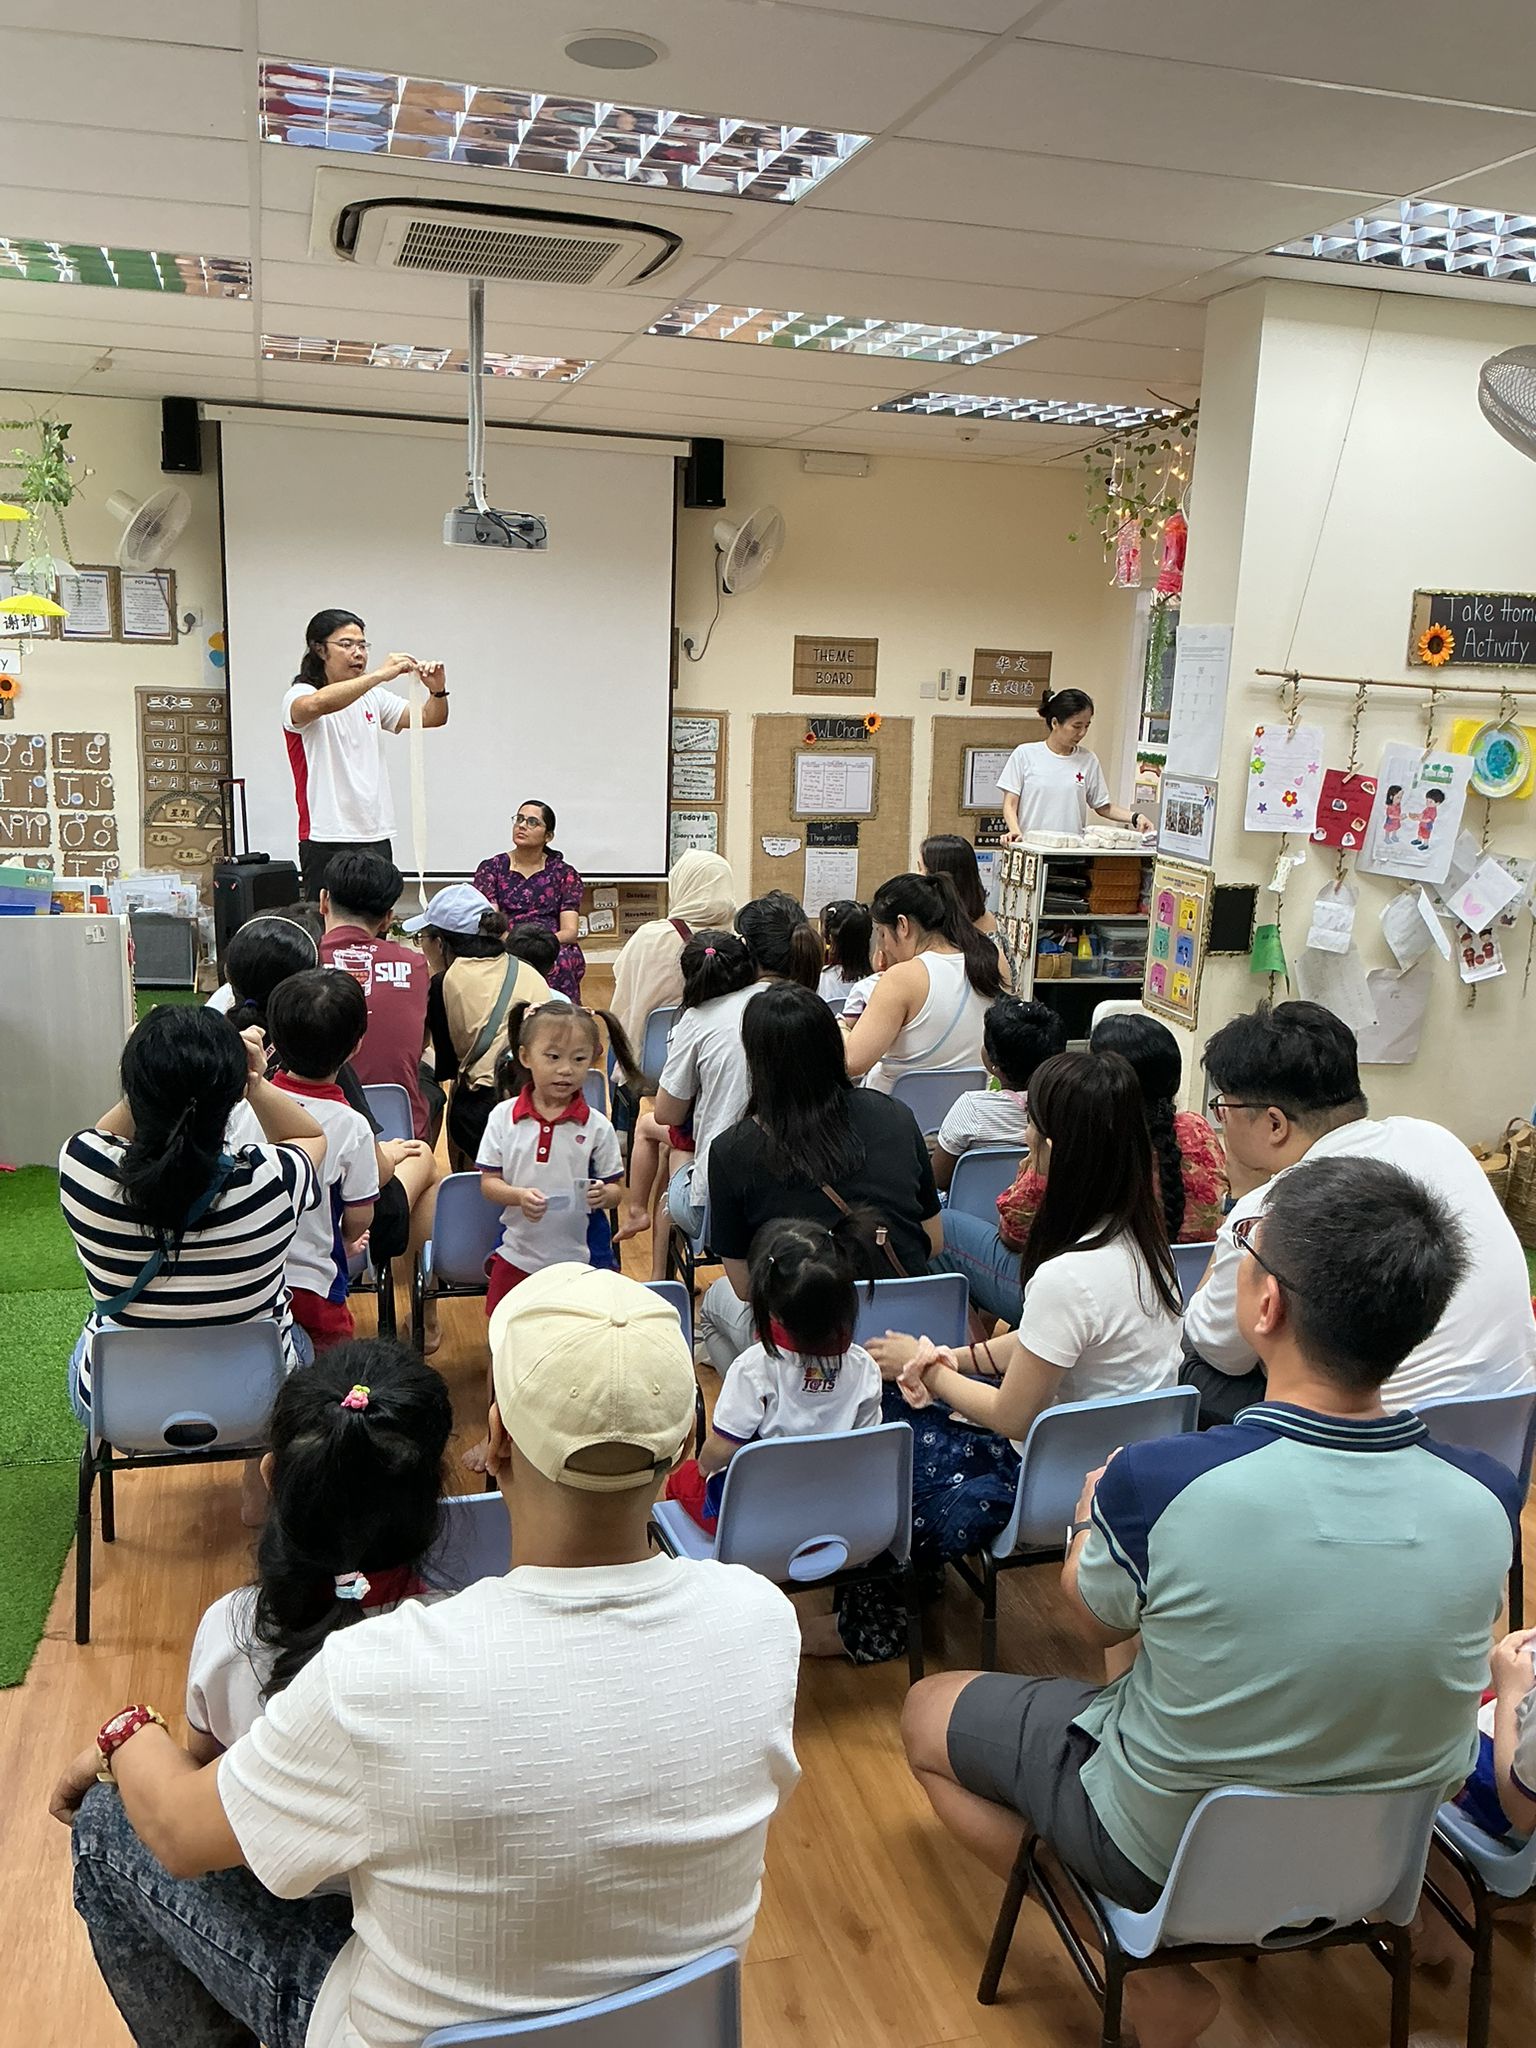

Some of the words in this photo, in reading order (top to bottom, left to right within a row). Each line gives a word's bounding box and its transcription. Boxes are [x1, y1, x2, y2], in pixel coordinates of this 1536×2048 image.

[1443, 597, 1494, 622] Take
[1500, 598, 1536, 622] Hom
[3, 613, 37, 630] 谢谢
[1462, 627, 1529, 663] Activity
[813, 648, 855, 663] THEME
[996, 655, 1029, 674] 华文
[815, 671, 854, 685] BOARD
[150, 719, 177, 731] 一月
[195, 719, 220, 732] 二月
[810, 720, 834, 739] KWL
[836, 720, 866, 739] Chart
[59, 738, 75, 763] E
[86, 742, 102, 764] e
[152, 738, 178, 751] 四月
[195, 740, 220, 751] 五月
[150, 758, 178, 771] 七月
[194, 759, 221, 772] 八月
[148, 775, 178, 788] 十月
[60, 777, 80, 806] J
[89, 781, 100, 807] j
[169, 808, 190, 819] 星期
[678, 814, 701, 822] Today
[151, 832, 177, 843] 星期一
[176, 850, 202, 859] 星期二
[375, 962, 412, 982] SUP
